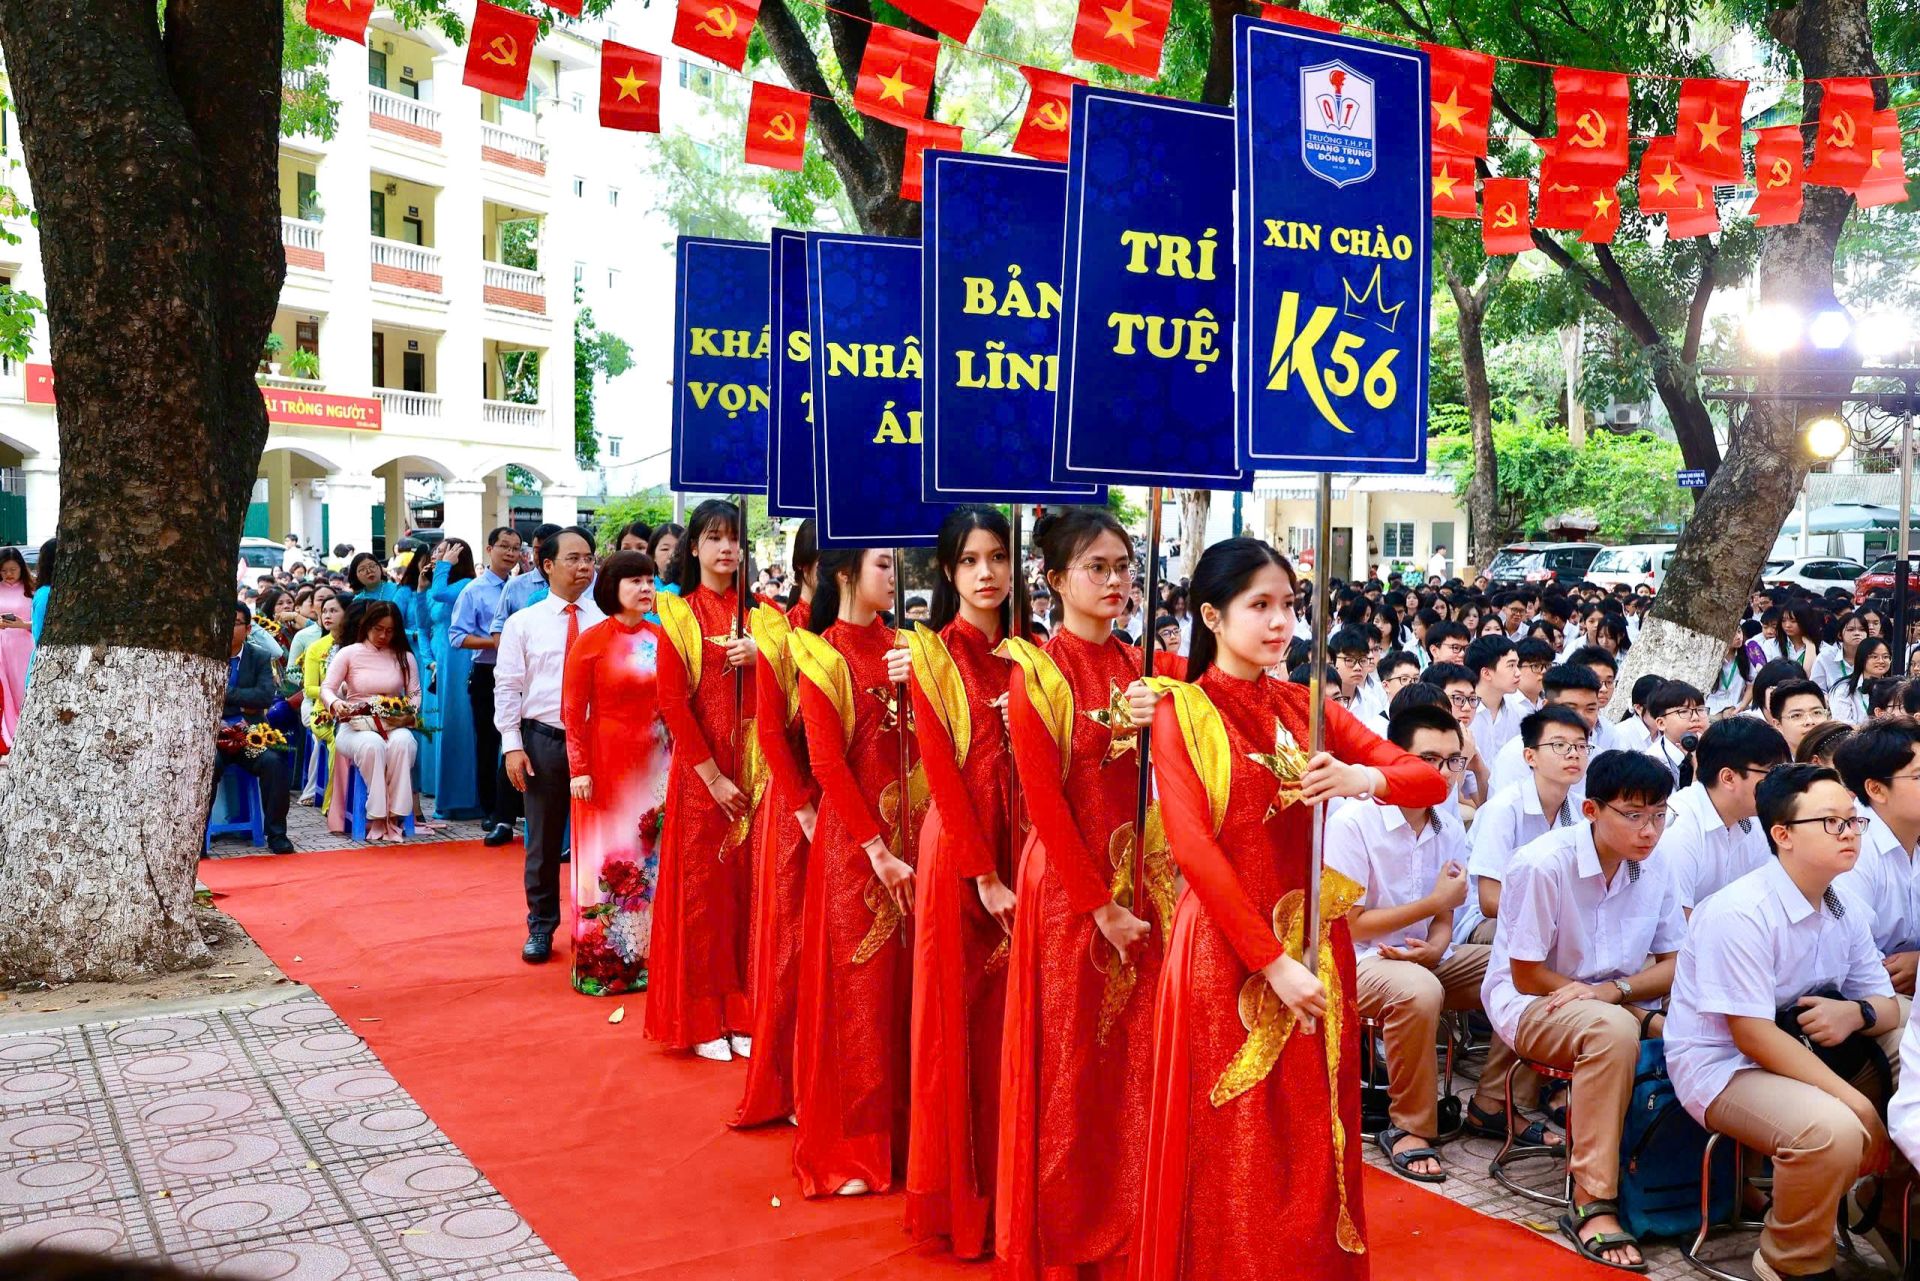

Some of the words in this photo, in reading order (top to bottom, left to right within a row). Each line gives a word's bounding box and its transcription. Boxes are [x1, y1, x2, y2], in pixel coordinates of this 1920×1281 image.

[1323, 99, 1334, 122] Q
[1344, 104, 1353, 124] T
[1306, 142, 1340, 153] QUANG
[1343, 147, 1372, 158] TRUNG
[1121, 228, 1218, 280] TRÍ
[1263, 219, 1322, 251] XIN
[1330, 225, 1413, 261] CHÀO
[963, 264, 1061, 318] BẢN
[689, 324, 769, 358] KHÁ
[826, 335, 922, 379] NHÂ
[1108, 308, 1220, 373] TUỆ
[1266, 291, 1400, 434] K56
[687, 381, 769, 419] VỌN
[873, 401, 922, 443] ÁI
